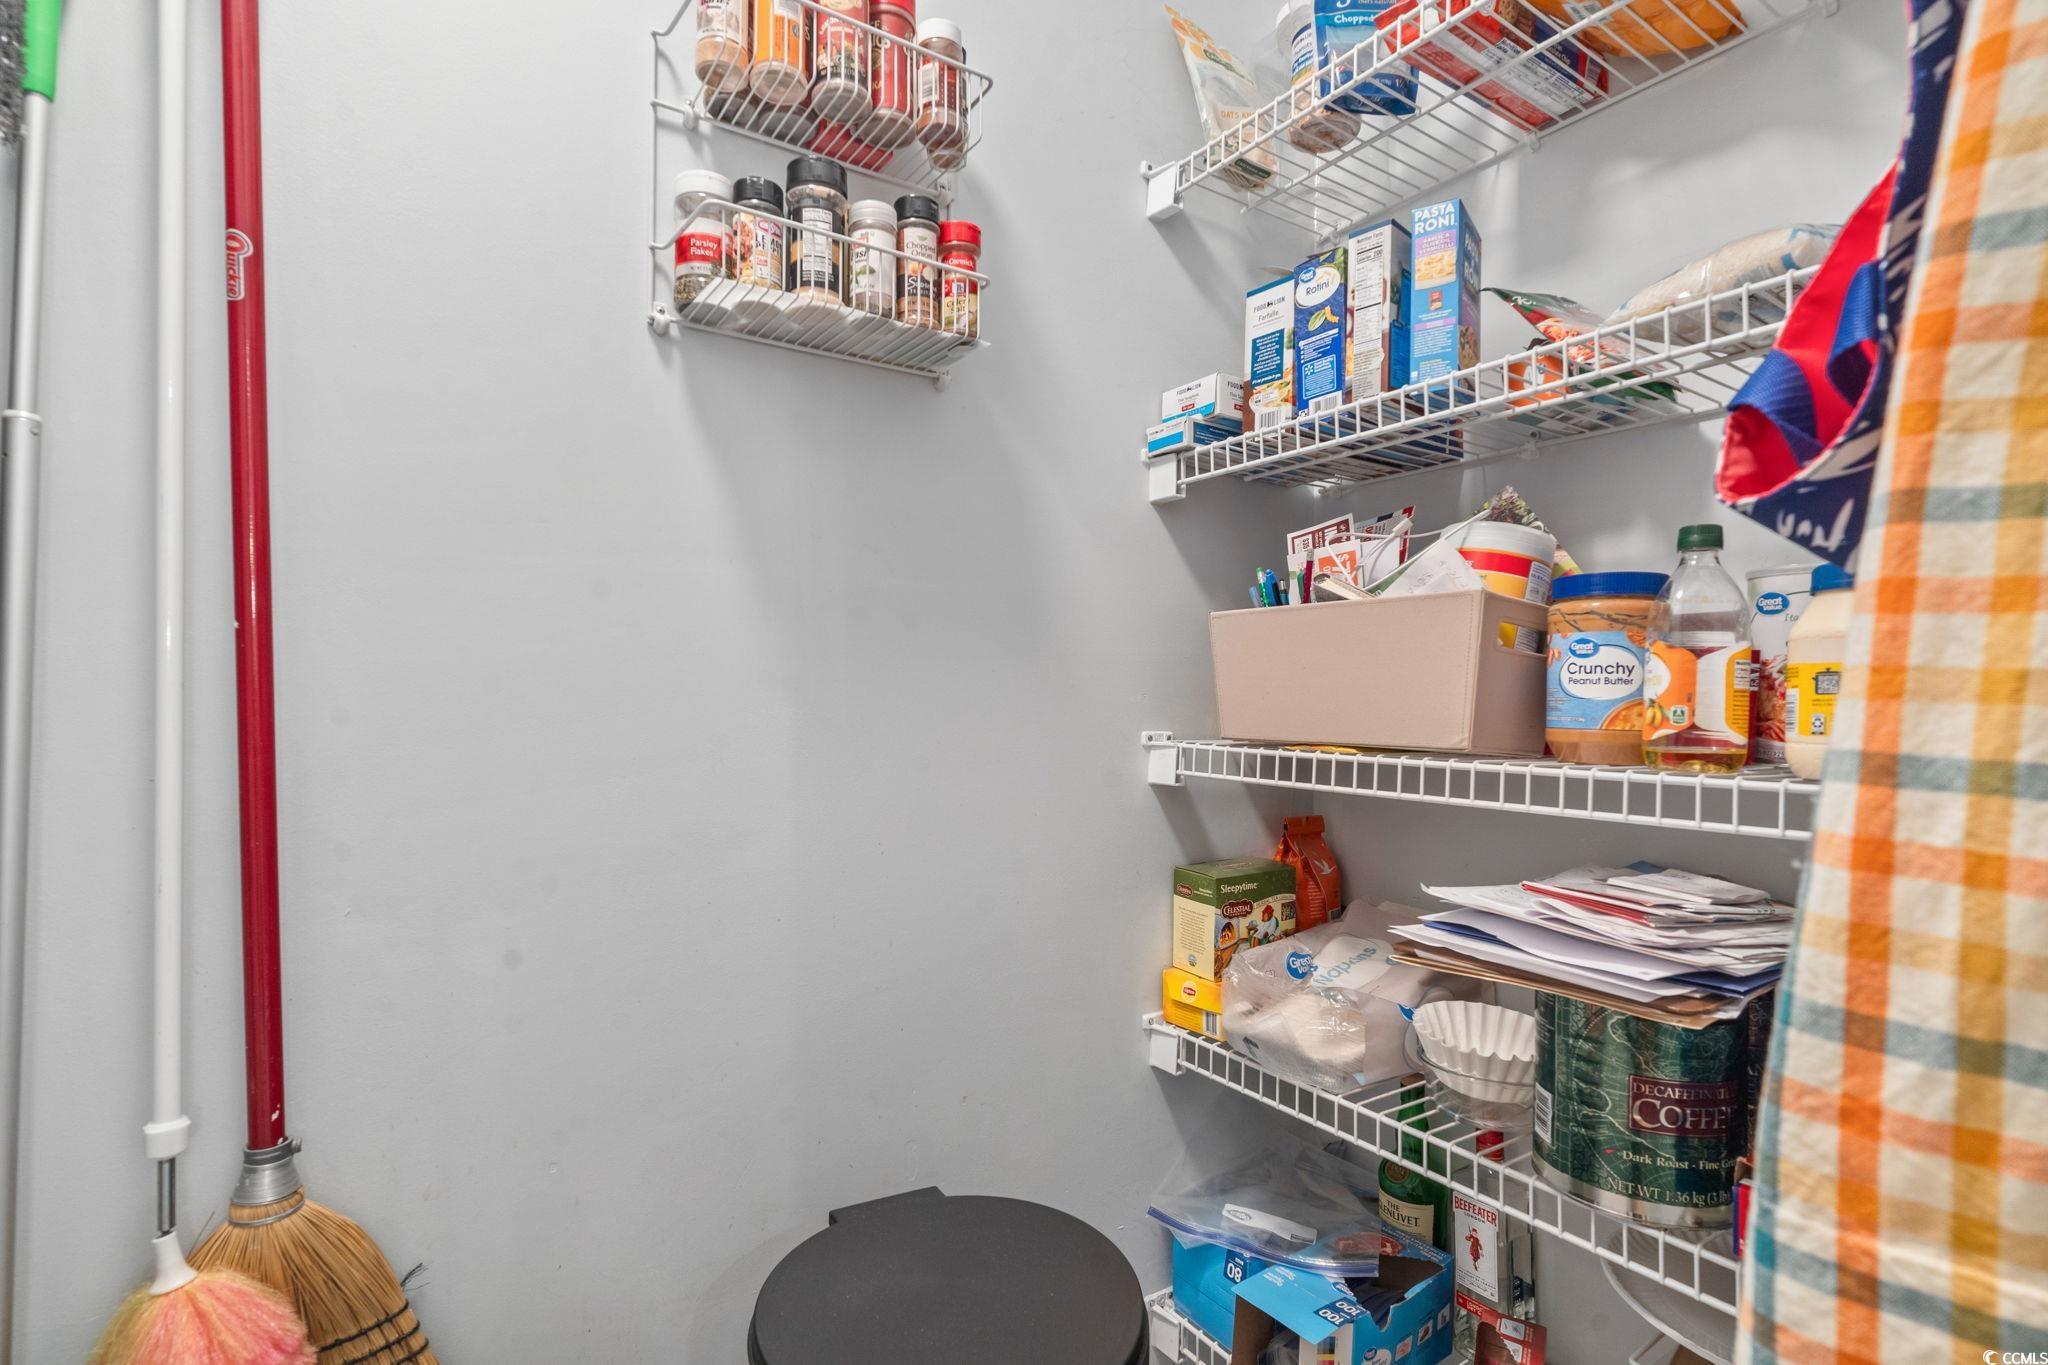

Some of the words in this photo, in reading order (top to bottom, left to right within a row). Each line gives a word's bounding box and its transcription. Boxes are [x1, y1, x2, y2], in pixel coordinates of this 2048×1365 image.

[1333, 14, 1375, 24] Chopped
[1414, 203, 1455, 222] PASTA
[1414, 213, 1456, 236] RONI
[690, 238, 718, 250] Parsley
[690, 246, 714, 257] Flakes
[1305, 280, 1330, 296] Rotini
[1758, 597, 1783, 607] Great
[1570, 642, 1594, 651] Great
[1567, 662, 1636, 678] Crunchy
[1568, 677, 1601, 685] Peanut
[1604, 677, 1634, 685] Butter
[1220, 881, 1258, 894] Sleepytime
[1223, 904, 1252, 916] CELESTIAL
[1623, 1150, 1655, 1166] Dark
[1657, 1157, 1689, 1169] Roast
[1700, 1160, 1720, 1170] Fine
[1607, 1177, 1636, 1195] NET
[1636, 1184, 1661, 1200] WT
[1666, 1191, 1690, 1202] 1.36
[1692, 1191, 1705, 1207] kg
[1387, 1200, 1401, 1212] THE
[1454, 1195, 1497, 1228] BEEFEATER
[1381, 1204, 1420, 1227] ENLIVET
[1227, 1263, 1242, 1283] 80
[1335, 1301, 1360, 1317] 100
[1319, 1309, 1345, 1326] 100
